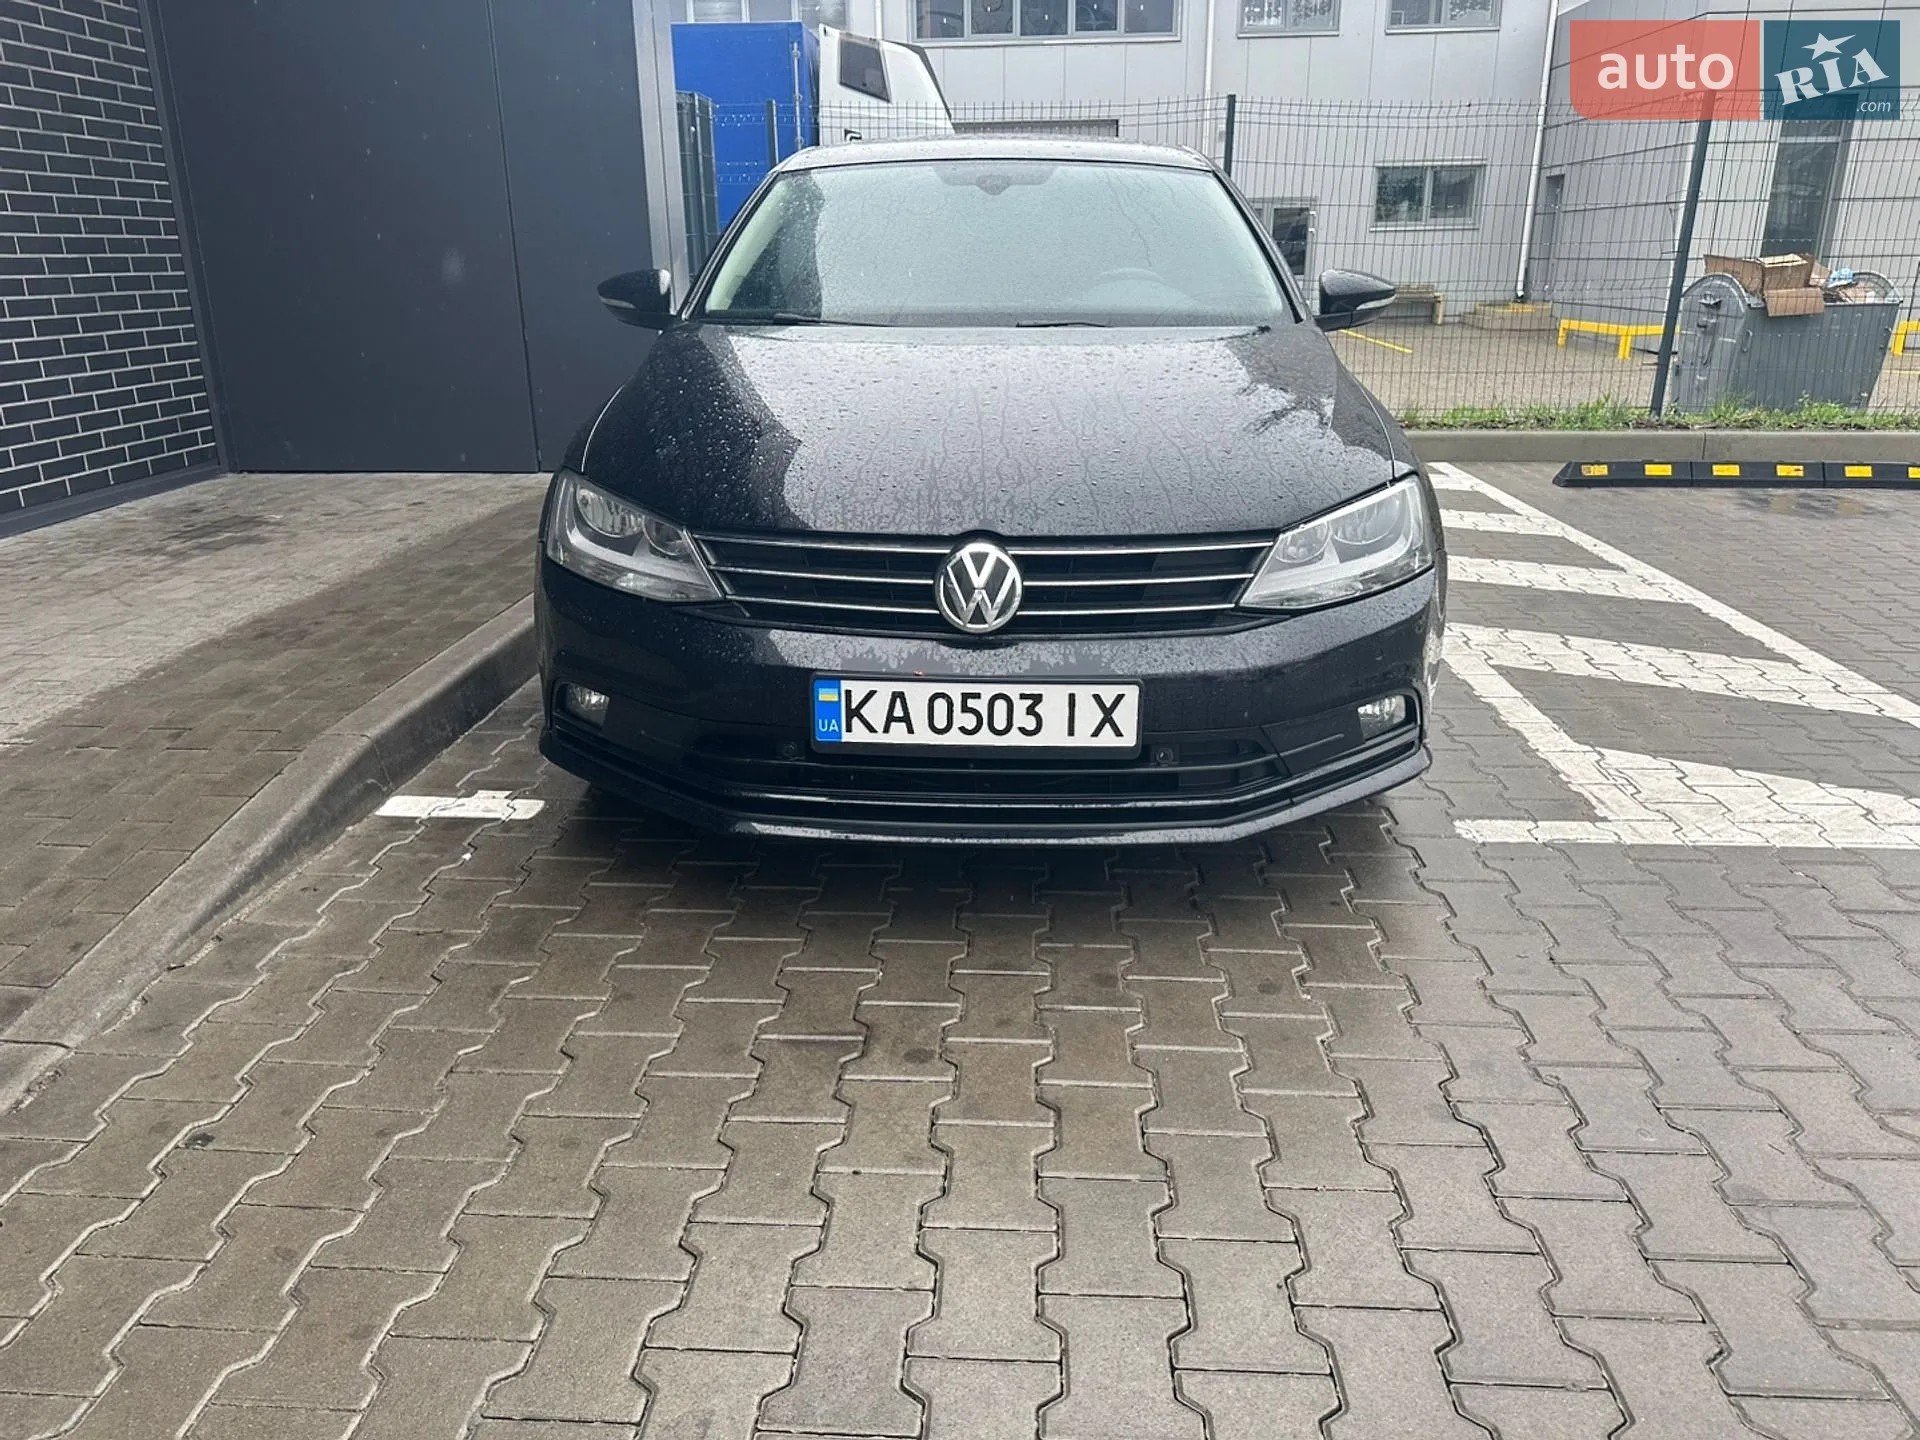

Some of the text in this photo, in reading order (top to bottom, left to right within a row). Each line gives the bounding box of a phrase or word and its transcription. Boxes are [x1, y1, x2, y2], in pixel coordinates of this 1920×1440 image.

[818, 719, 840, 733] UA
[844, 689, 915, 735] KA
[927, 692, 1044, 737] 0503
